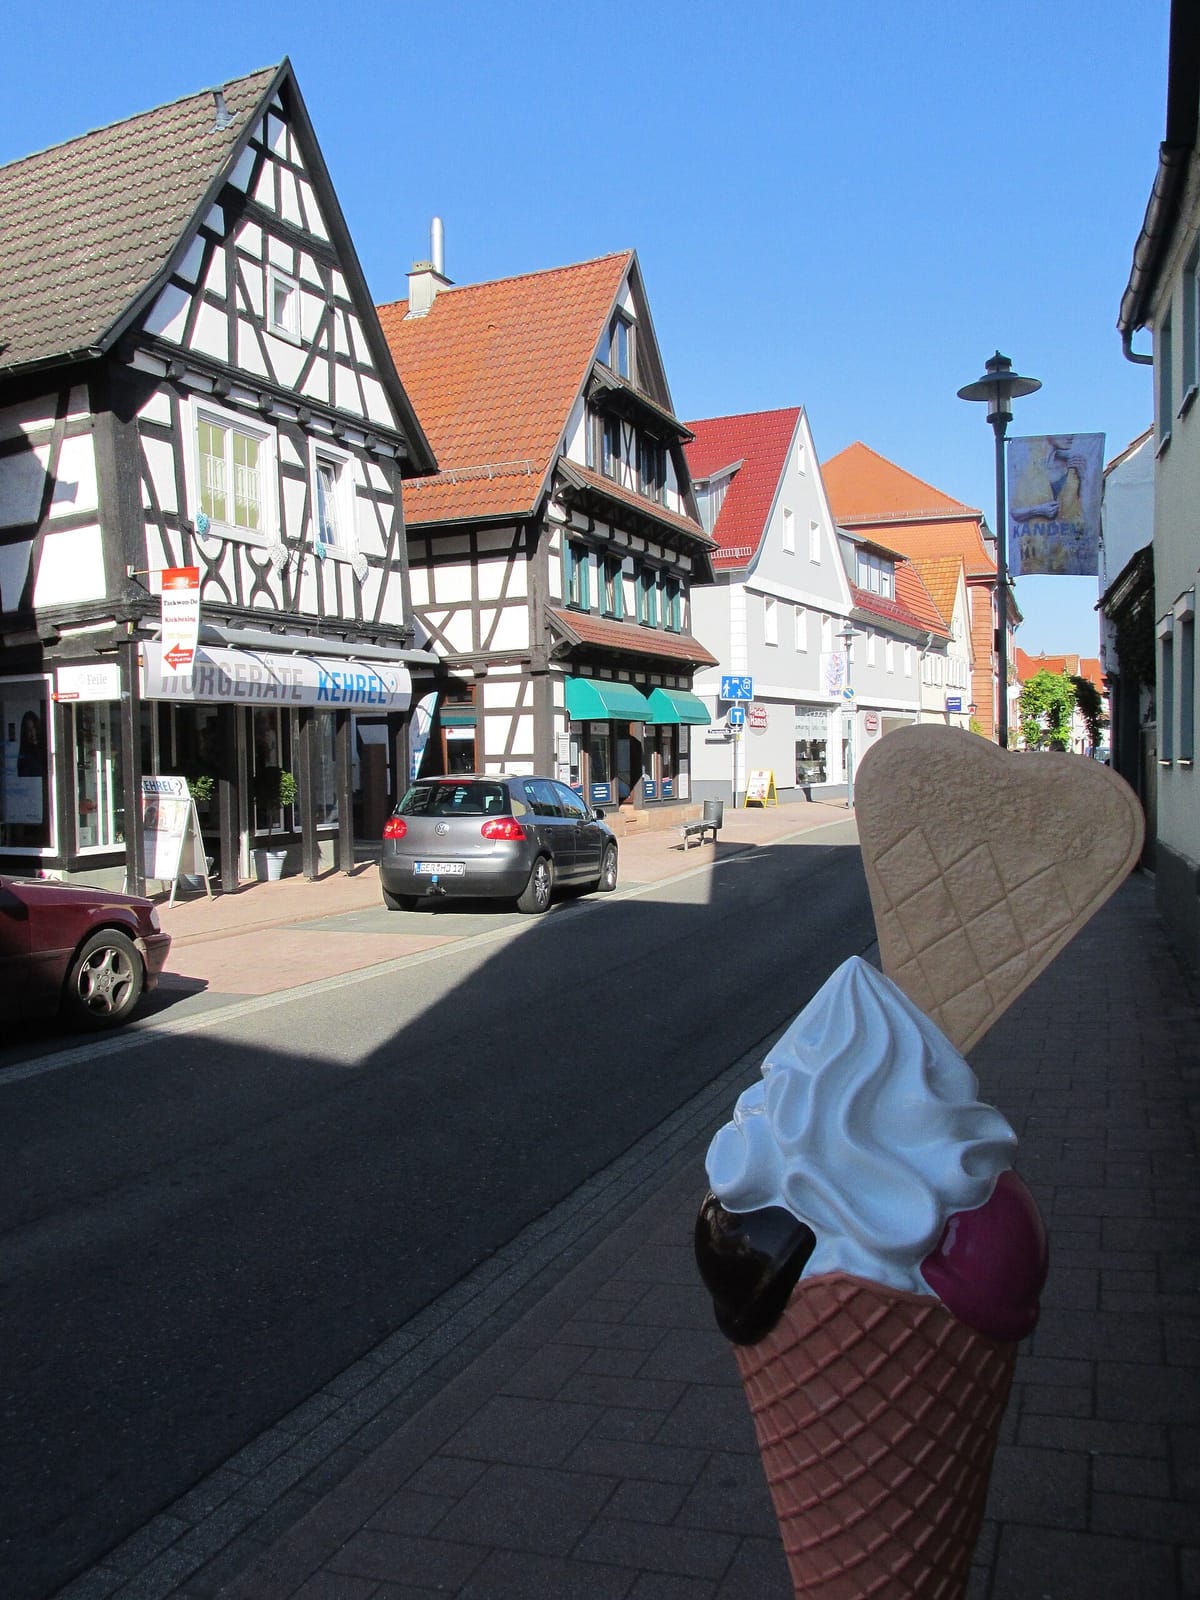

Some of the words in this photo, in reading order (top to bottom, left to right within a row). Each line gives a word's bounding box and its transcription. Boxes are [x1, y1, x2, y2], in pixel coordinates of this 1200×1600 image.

[317, 670, 387, 704] KEHREL
[142, 780, 175, 792] EHREL
[452, 864, 463, 873] 12
